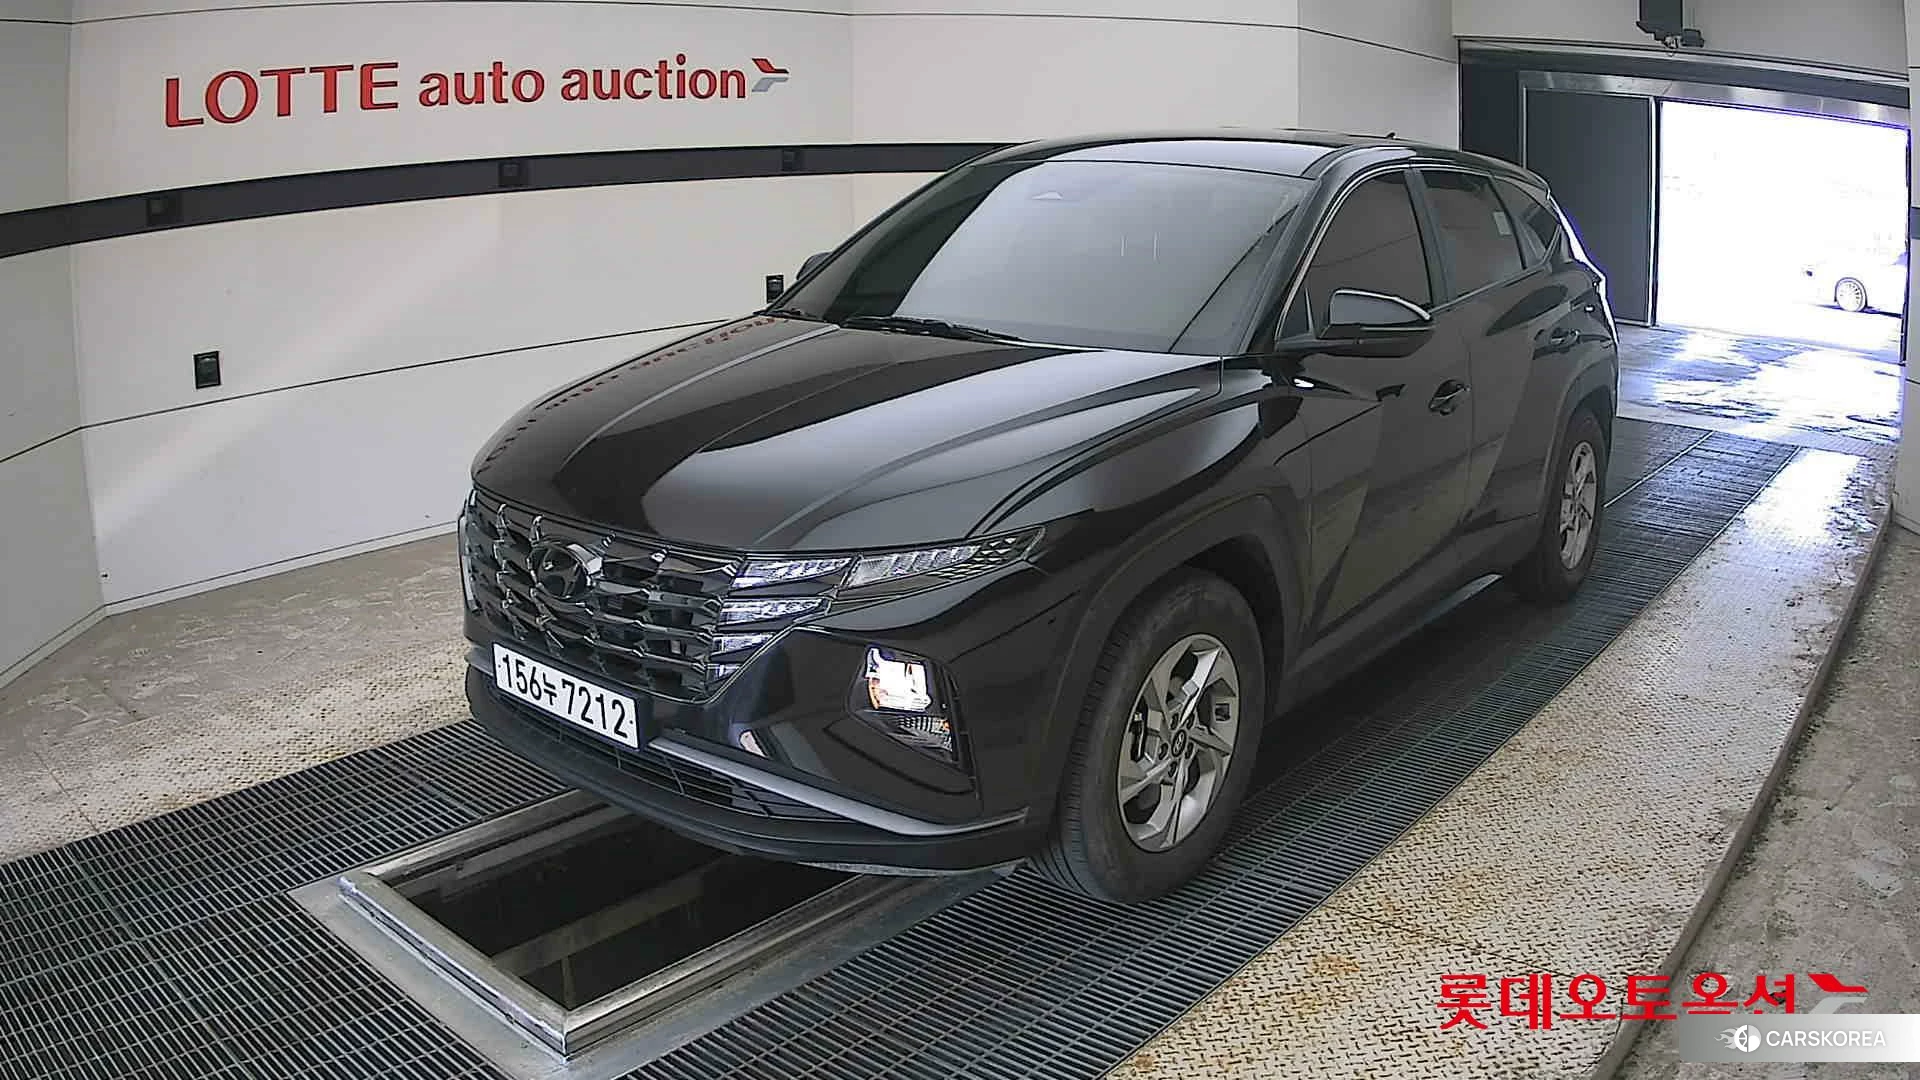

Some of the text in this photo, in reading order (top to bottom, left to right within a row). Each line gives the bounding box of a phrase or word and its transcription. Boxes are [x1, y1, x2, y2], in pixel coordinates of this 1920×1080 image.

[165, 53, 748, 128] LOTTE auto auction
[502, 654, 628, 739] 156누7212
